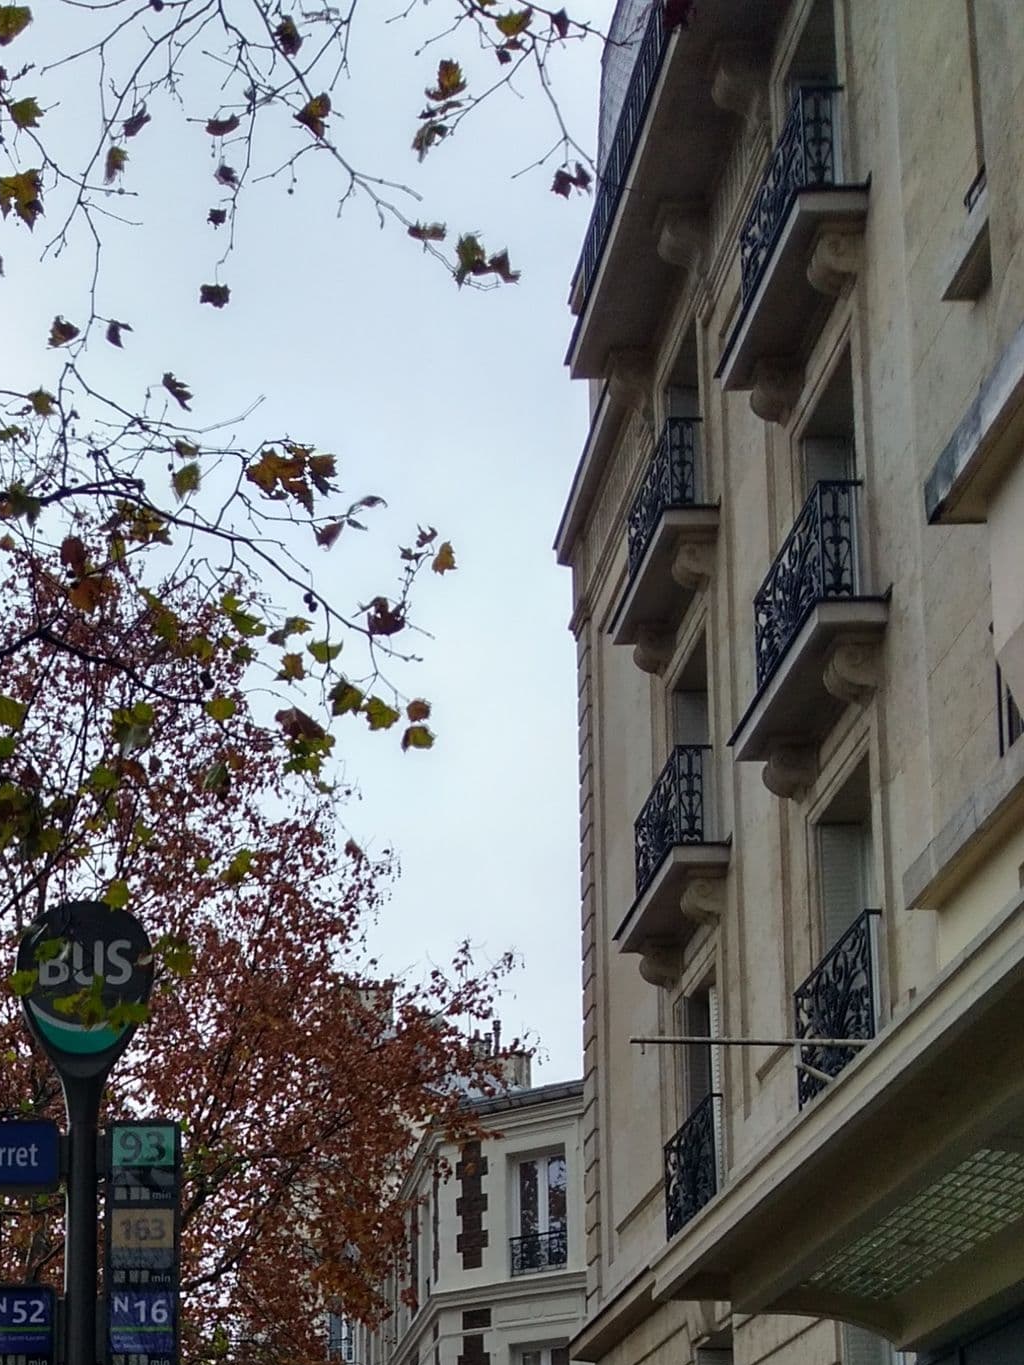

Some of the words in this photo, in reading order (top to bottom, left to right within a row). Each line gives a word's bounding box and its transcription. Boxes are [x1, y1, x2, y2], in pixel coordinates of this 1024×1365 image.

[38, 939, 133, 986] BUS
[119, 1131, 167, 1163] 93
[150, 1271, 172, 1283] min
